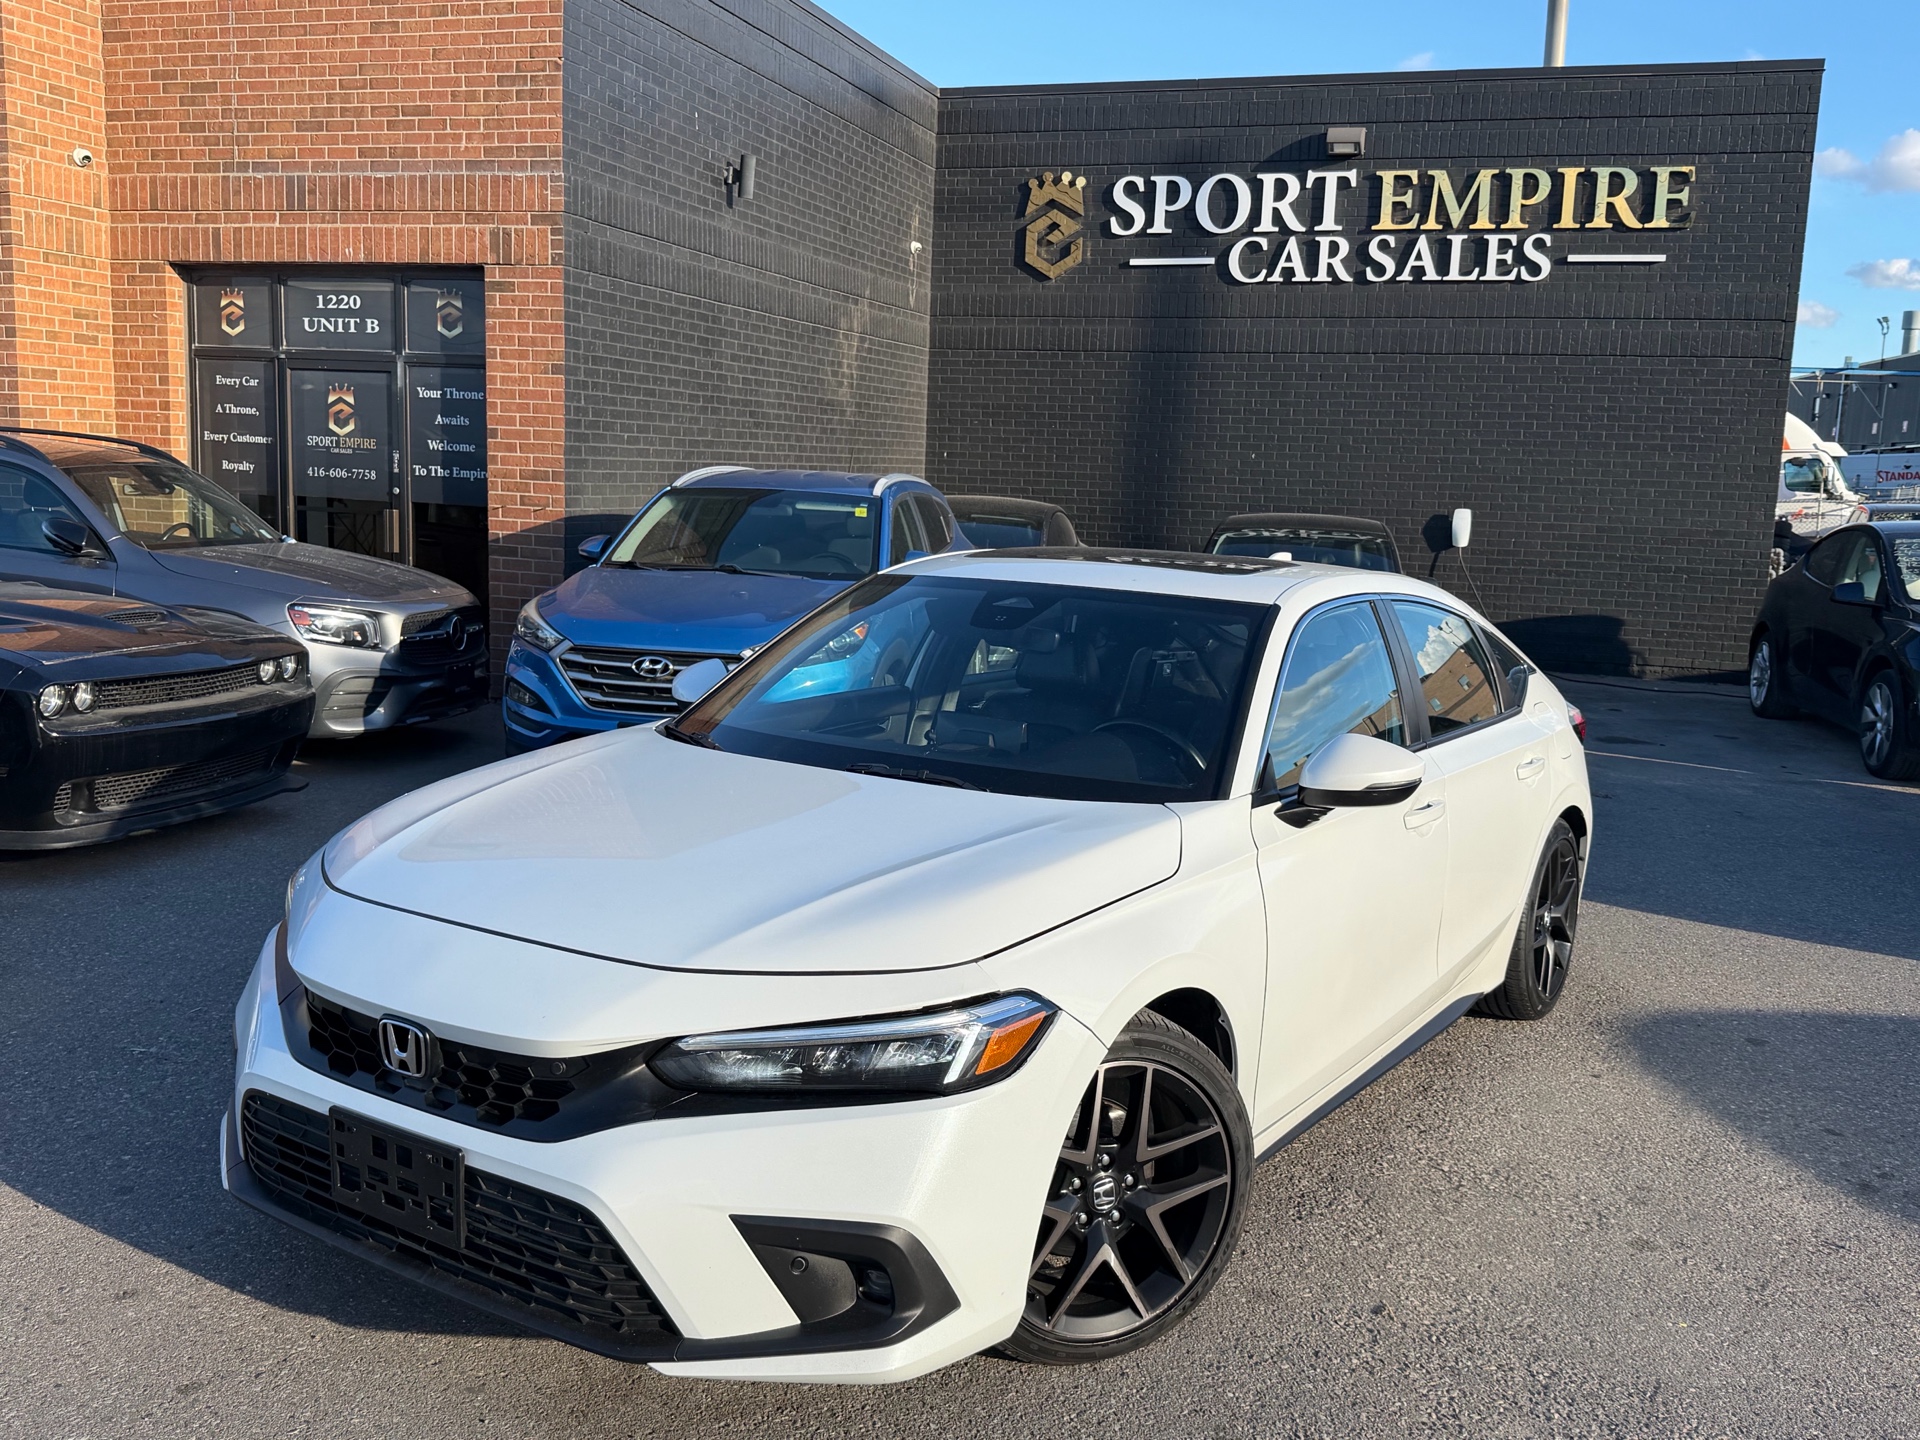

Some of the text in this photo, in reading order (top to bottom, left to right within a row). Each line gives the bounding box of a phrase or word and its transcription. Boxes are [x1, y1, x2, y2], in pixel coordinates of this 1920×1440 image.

[1110, 166, 1697, 236] SPORT EMPIRE
[1228, 233, 1552, 284] CAR SALES
[316, 294, 362, 310] 1220
[302, 317, 380, 334] UNIT B
[215, 374, 259, 388] Every Car
[416, 386, 484, 400] Your Throne
[215, 403, 260, 417] A Throne,
[434, 413, 470, 426] Awaits
[204, 430, 273, 444] Every Customer
[307, 435, 377, 449] SPORT EMPIRE
[427, 439, 476, 452] Welcome
[222, 459, 255, 474] Royalty
[307, 466, 377, 480] 416-606-7758
[412, 464, 488, 481] To The Empir
